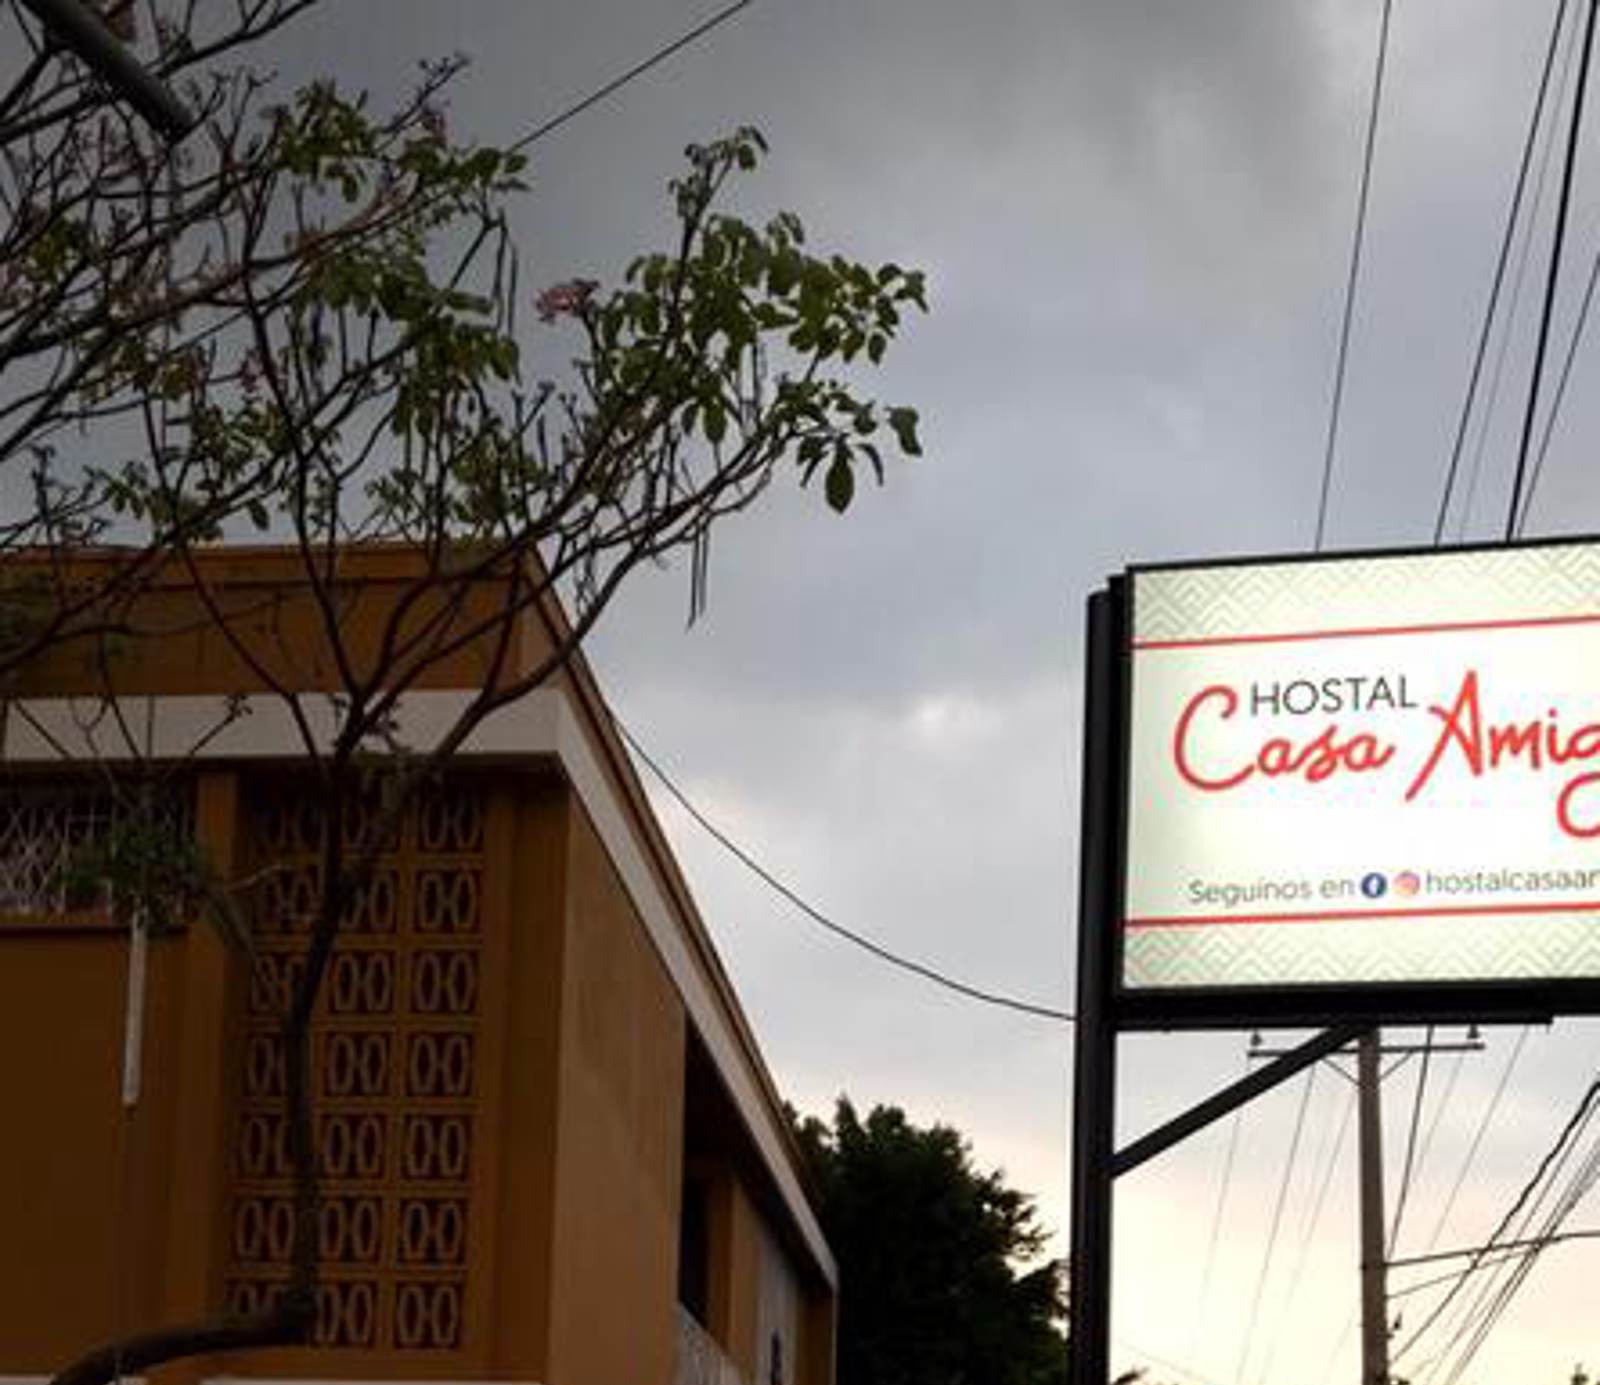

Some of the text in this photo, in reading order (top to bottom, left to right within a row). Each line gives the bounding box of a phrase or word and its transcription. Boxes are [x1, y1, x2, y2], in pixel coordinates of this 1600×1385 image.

[1250, 675, 1418, 717] HOSTAL
[1174, 684, 1395, 791] Casa
[1320, 879, 1355, 898] en
